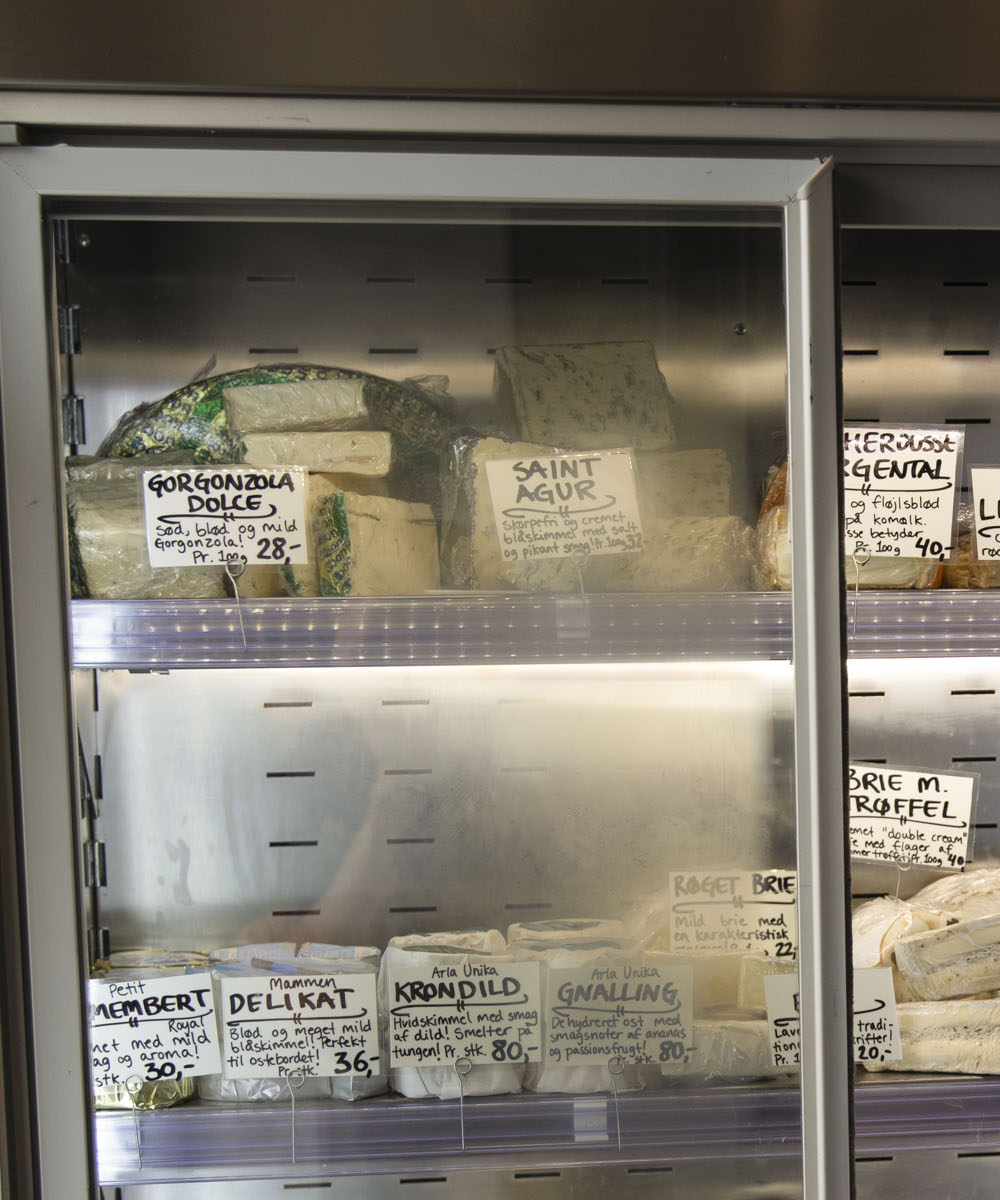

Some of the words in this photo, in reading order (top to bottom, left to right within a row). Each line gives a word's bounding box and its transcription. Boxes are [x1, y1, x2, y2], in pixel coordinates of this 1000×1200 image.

[513, 458, 601, 481] SAINT
[148, 473, 294, 498] GORGONZOLA
[516, 480, 597, 504] AGUR
[188, 494, 262, 512] DOLCE
[872, 495, 939, 513] fløjlsblød
[156, 523, 190, 536] Sød,
[196, 523, 229, 536] blød
[263, 516, 297, 532] mild
[564, 519, 577, 530] og
[582, 511, 626, 524] cremet
[503, 529, 576, 544] blåskimmel
[870, 528, 923, 540] betyder
[155, 535, 243, 553] Gorgonzola!
[257, 537, 301, 564] 28,-
[522, 543, 559, 559] pikant
[916, 537, 955, 561] 40,-
[918, 777, 947, 792] M.
[893, 841, 930, 851] flager
[674, 875, 741, 898] RØGET
[752, 873, 795, 895] BRIE
[721, 914, 748, 926] brie
[432, 967, 457, 979] Arla
[464, 963, 498, 977] Unika
[592, 969, 617, 980] Arla
[624, 966, 661, 979] Unika
[109, 981, 145, 998] Petit
[270, 978, 337, 990] Mammen
[395, 977, 521, 1003] KRONDILD
[229, 989, 355, 1015] DELIKAT
[558, 982, 678, 1006] GNALLING
[168, 1016, 204, 1033] Royal
[394, 1012, 472, 1030] Hvidskimmel
[508, 1010, 538, 1026] smag
[552, 1015, 619, 1031] Dehydreret
[173, 1030, 210, 1046] mild
[230, 1028, 263, 1040] Blød
[295, 1022, 335, 1039] meget
[343, 1020, 371, 1032] mild
[414, 1026, 450, 1041] dild!
[455, 1025, 512, 1040] Smelter
[550, 1030, 623, 1045] smagsnoter
[646, 1029, 686, 1039] ananas
[140, 1046, 200, 1061] aroma!
[231, 1036, 314, 1053] blåskimmel!
[322, 1036, 366, 1049] Perfekt
[392, 1043, 440, 1061] tungen!
[492, 1040, 538, 1064] 80,-
[567, 1040, 646, 1061] passionsfrugt!
[659, 1040, 697, 1063] 80,-
[858, 1046, 891, 1061] 20,-
[145, 1062, 194, 1080] 30,-
[250, 1049, 319, 1066] ostebordet!
[334, 1051, 379, 1077] 36,-
